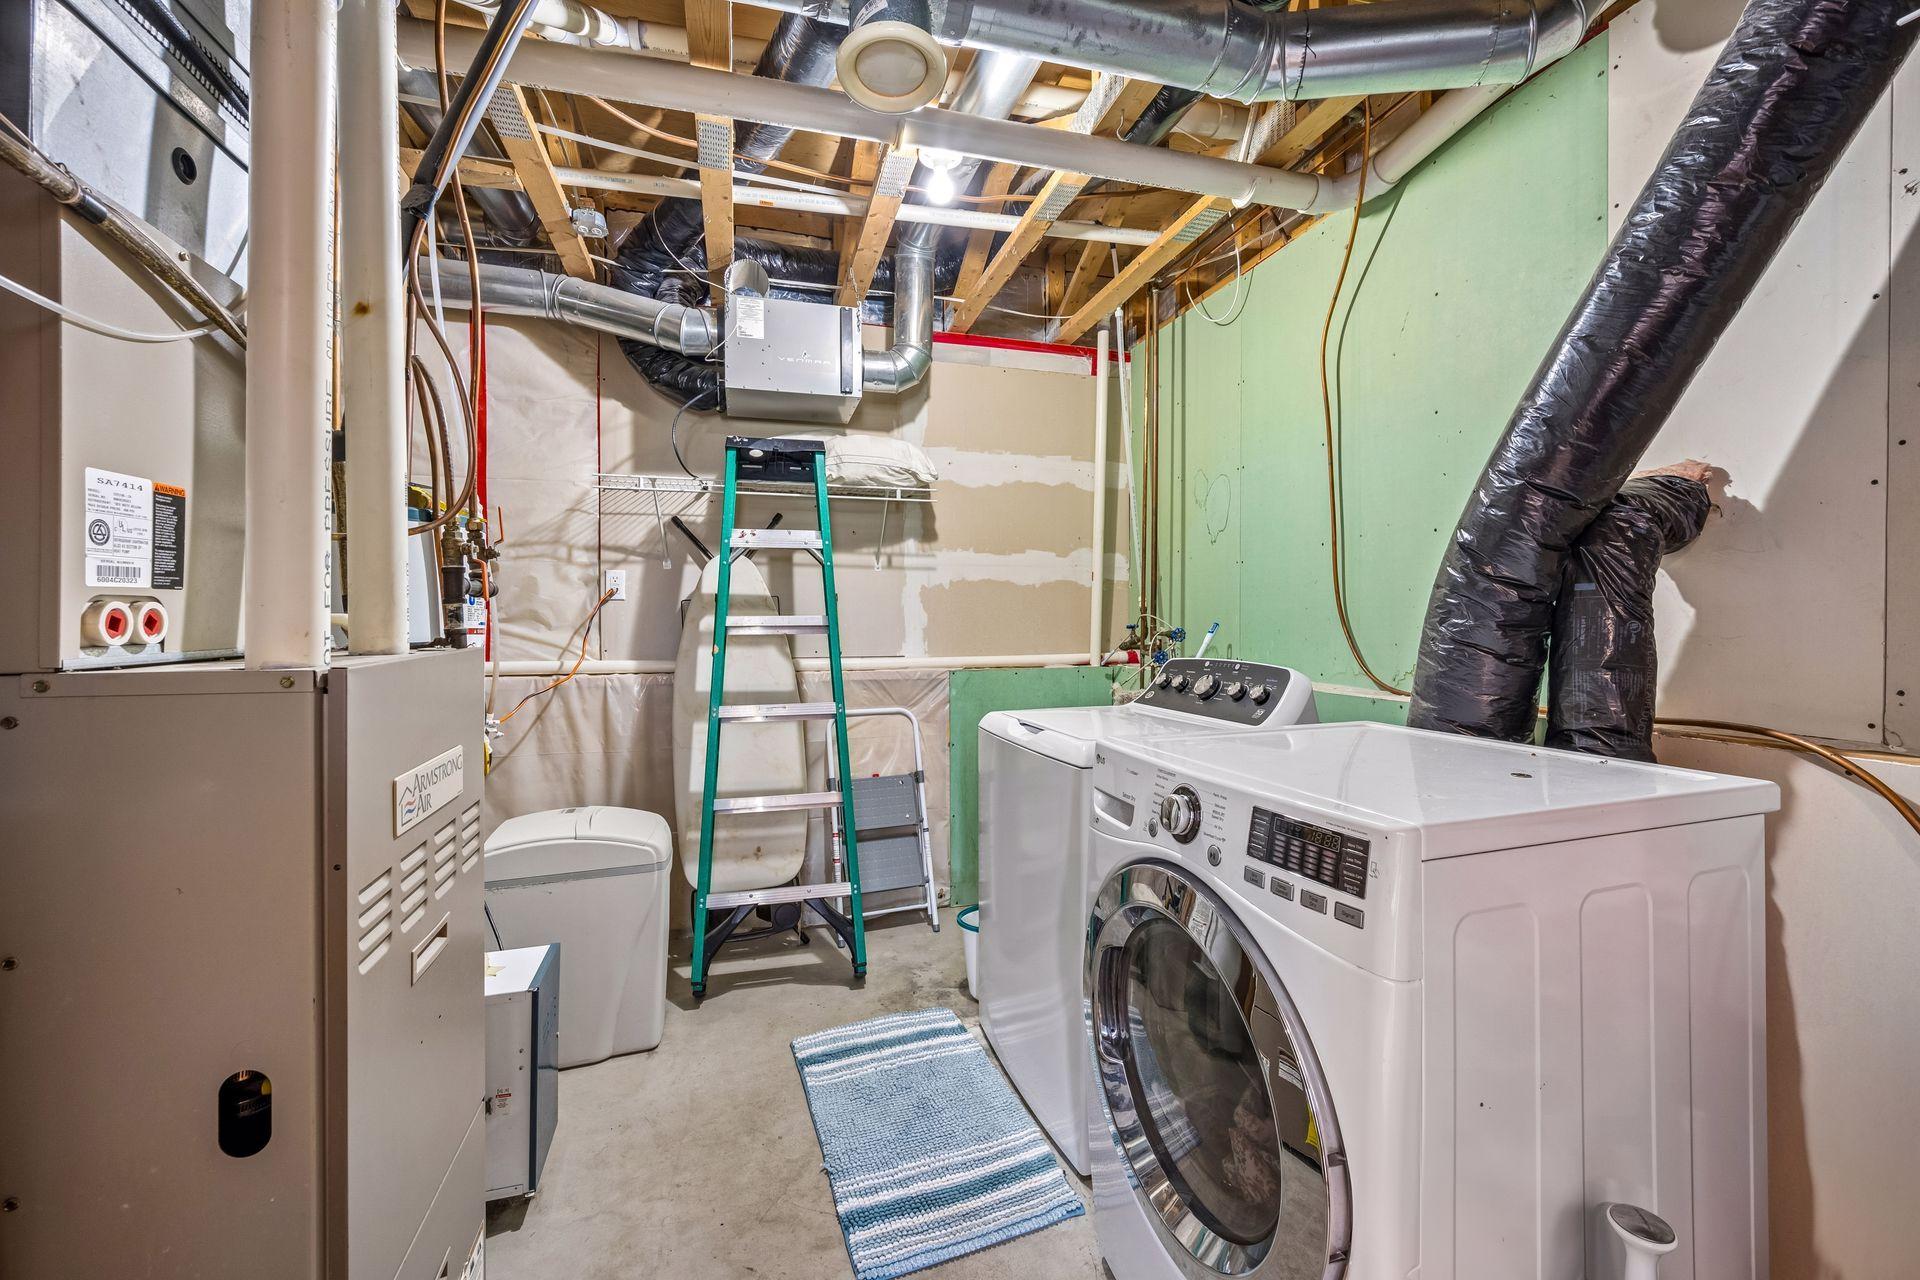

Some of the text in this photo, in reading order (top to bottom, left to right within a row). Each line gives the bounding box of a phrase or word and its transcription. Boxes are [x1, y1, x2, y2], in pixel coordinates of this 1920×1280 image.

[97, 477, 143, 492] SA7414
[159, 485, 186, 497] WARNING
[412, 753, 463, 797] ARMSTRONG
[415, 793, 433, 818] AIR
